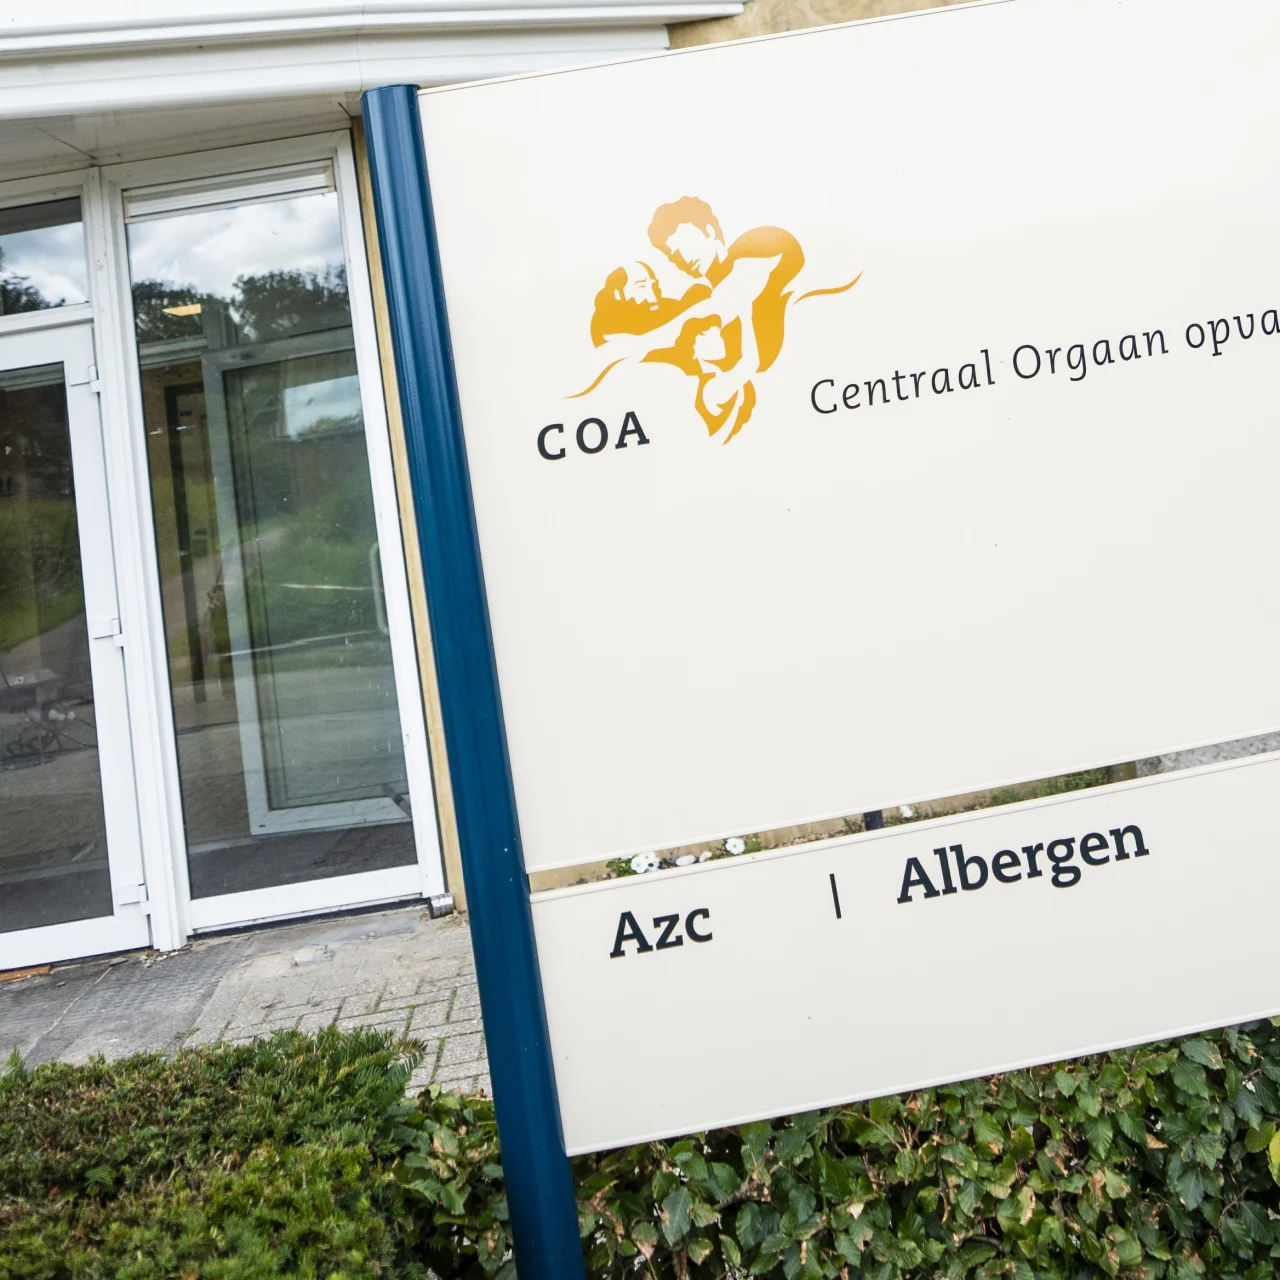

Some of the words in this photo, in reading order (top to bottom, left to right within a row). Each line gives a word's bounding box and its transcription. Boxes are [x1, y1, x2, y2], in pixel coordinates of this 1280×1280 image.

[809, 348, 997, 414] Centraal
[1011, 328, 1170, 382] Orgaan
[536, 410, 650, 461] COA
[609, 907, 713, 959] Azc
[896, 823, 1151, 905] Albergen
